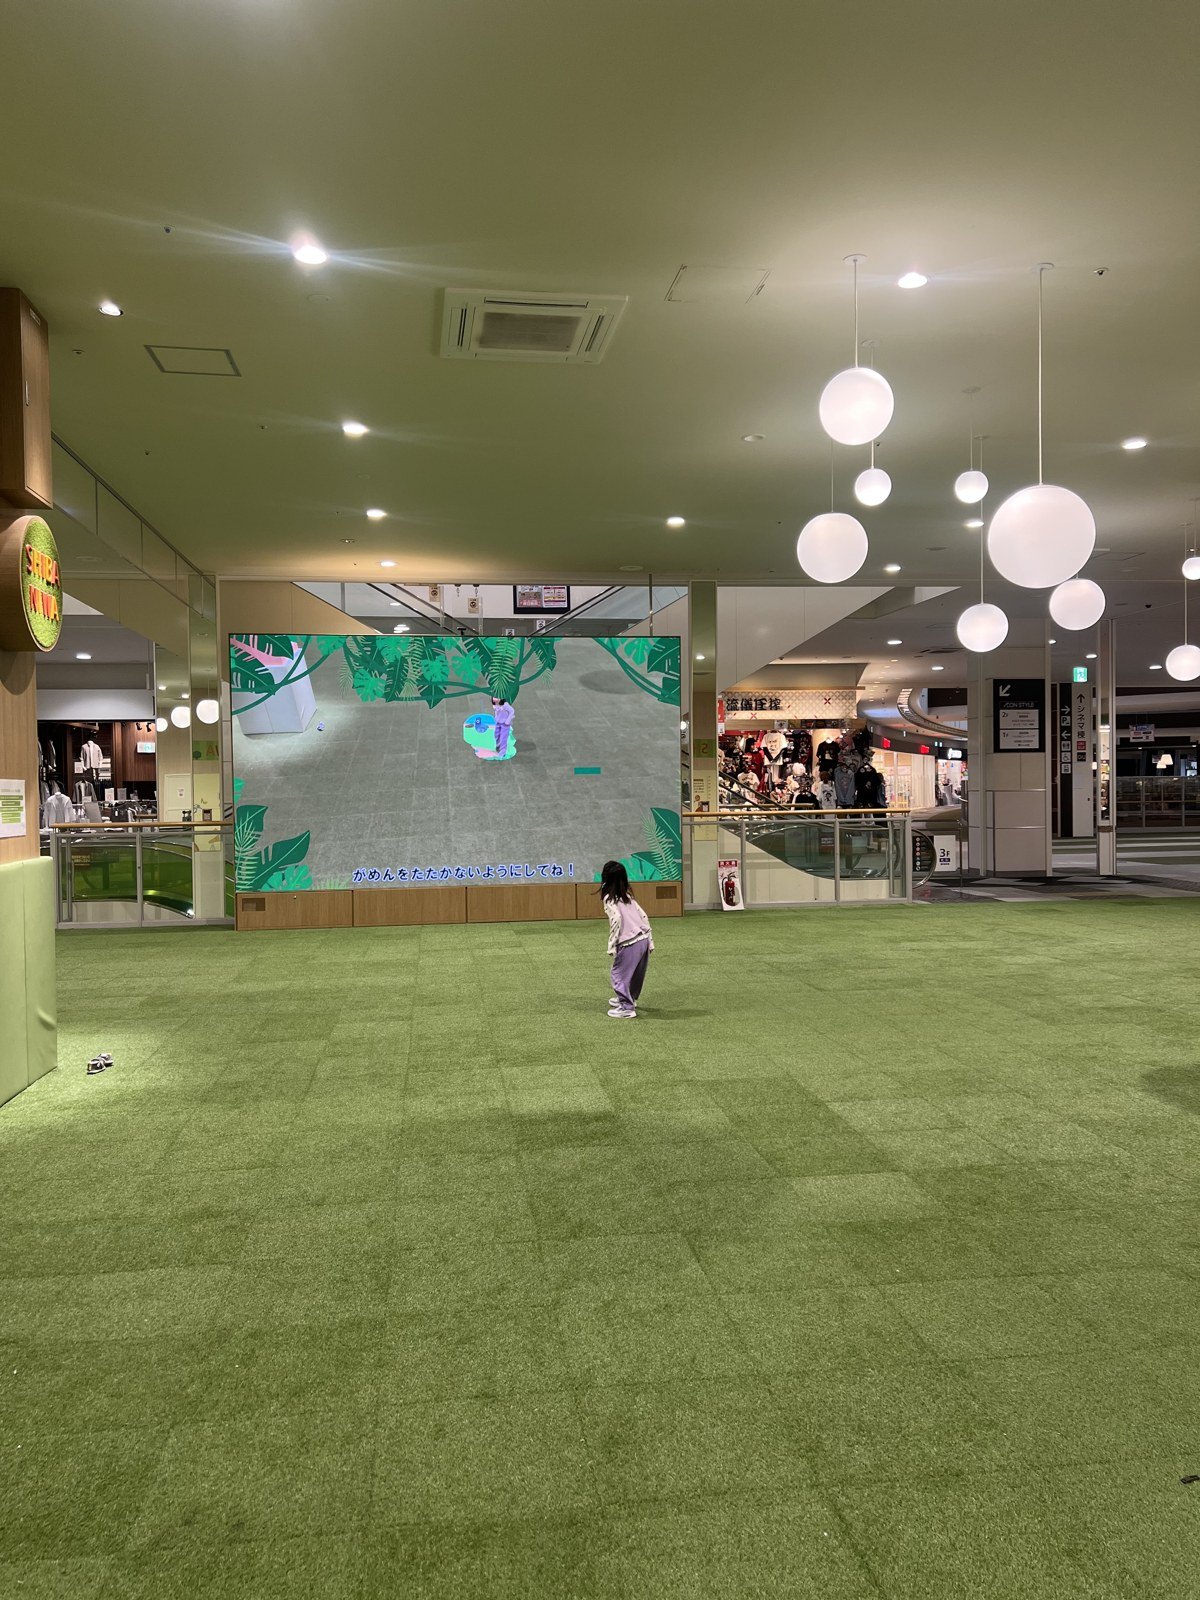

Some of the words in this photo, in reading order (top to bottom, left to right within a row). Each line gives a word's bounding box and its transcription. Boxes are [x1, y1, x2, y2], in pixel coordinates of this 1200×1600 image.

[25, 544, 60, 588] SHIBA
[28, 583, 60, 622] NIWA
[939, 848, 951, 858] 3F
[352, 863, 575, 883] がめんをたたかないようにしてね！
